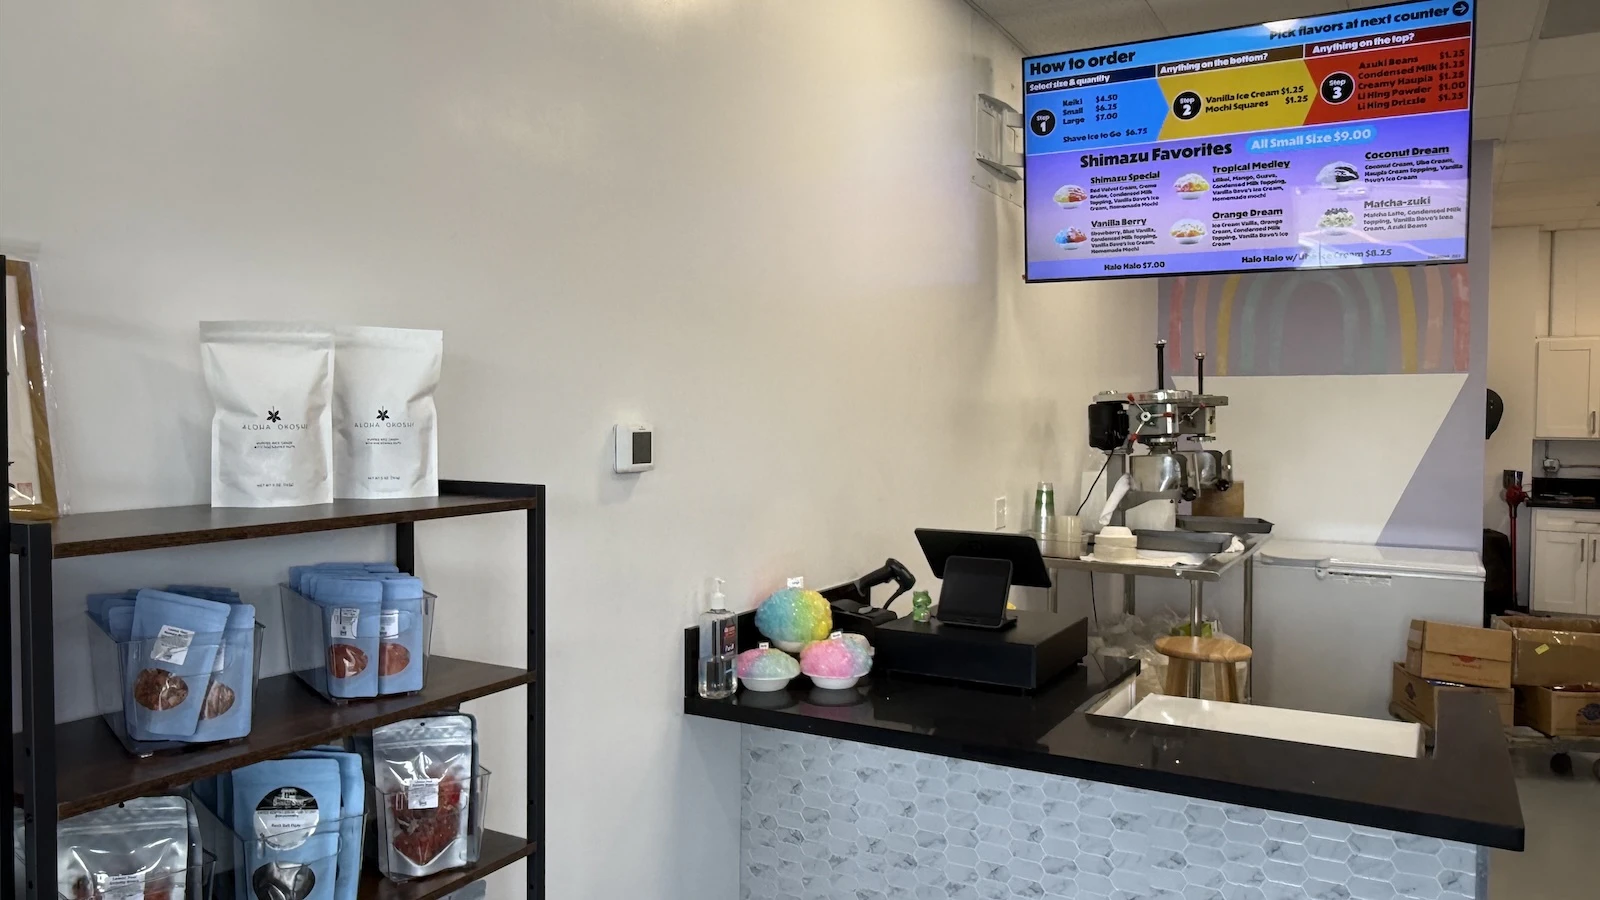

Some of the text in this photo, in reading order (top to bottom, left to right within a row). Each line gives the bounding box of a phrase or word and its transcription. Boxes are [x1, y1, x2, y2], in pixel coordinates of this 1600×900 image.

[1269, 6, 1449, 40] Pick flavors at next counter
[1312, 32, 1415, 55] Anything on the top?
[1030, 51, 1136, 75] How to order
[1160, 52, 1268, 75] Anything on the bottom?
[1359, 49, 1465, 69] Azuki Beans $1.25
[1358, 60, 1465, 80] Condensed Milk $1.25
[1029, 75, 1111, 92] Select size & quantity
[1329, 79, 1346, 87] Step
[1358, 71, 1465, 90] Creamy Haupia $1.25
[1206, 85, 1304, 104] Vanilla Ice Cream $1.25
[1332, 86, 1342, 99] 3
[1358, 81, 1466, 100] Li Hing Powder $1.00
[1062, 94, 1118, 107] Keiki $4.50
[1180, 97, 1195, 105] Step
[1205, 95, 1308, 113] Mochi Squares $1.25
[1358, 92, 1464, 111] Li Hing Drizzle $1.25
[1062, 103, 1118, 116] Small $6.25
[1183, 104, 1192, 116] 2
[1062, 112, 1118, 126] Large $7.00
[1040, 122, 1047, 132] 1
[1063, 127, 1148, 143] Shave Ice to Go $6.75
[1251, 129, 1372, 150] All Small Size $9.00
[1080, 143, 1233, 168] Shimazu Favorites
[1365, 146, 1449, 160] Coconut Dream
[1212, 160, 1291, 174] Tropical Medley
[1090, 170, 1160, 184] Shimazu Special
[1364, 196, 1431, 209] Matcha-zuki
[1212, 209, 1283, 219] Orange Dream
[1091, 218, 1147, 228] Vanilla Berry
[1241, 255, 1261, 263] Halo
[1263, 254, 1284, 262] Halo
[1286, 253, 1298, 262] w/
[1104, 261, 1165, 271] Halo Halo $7.00
